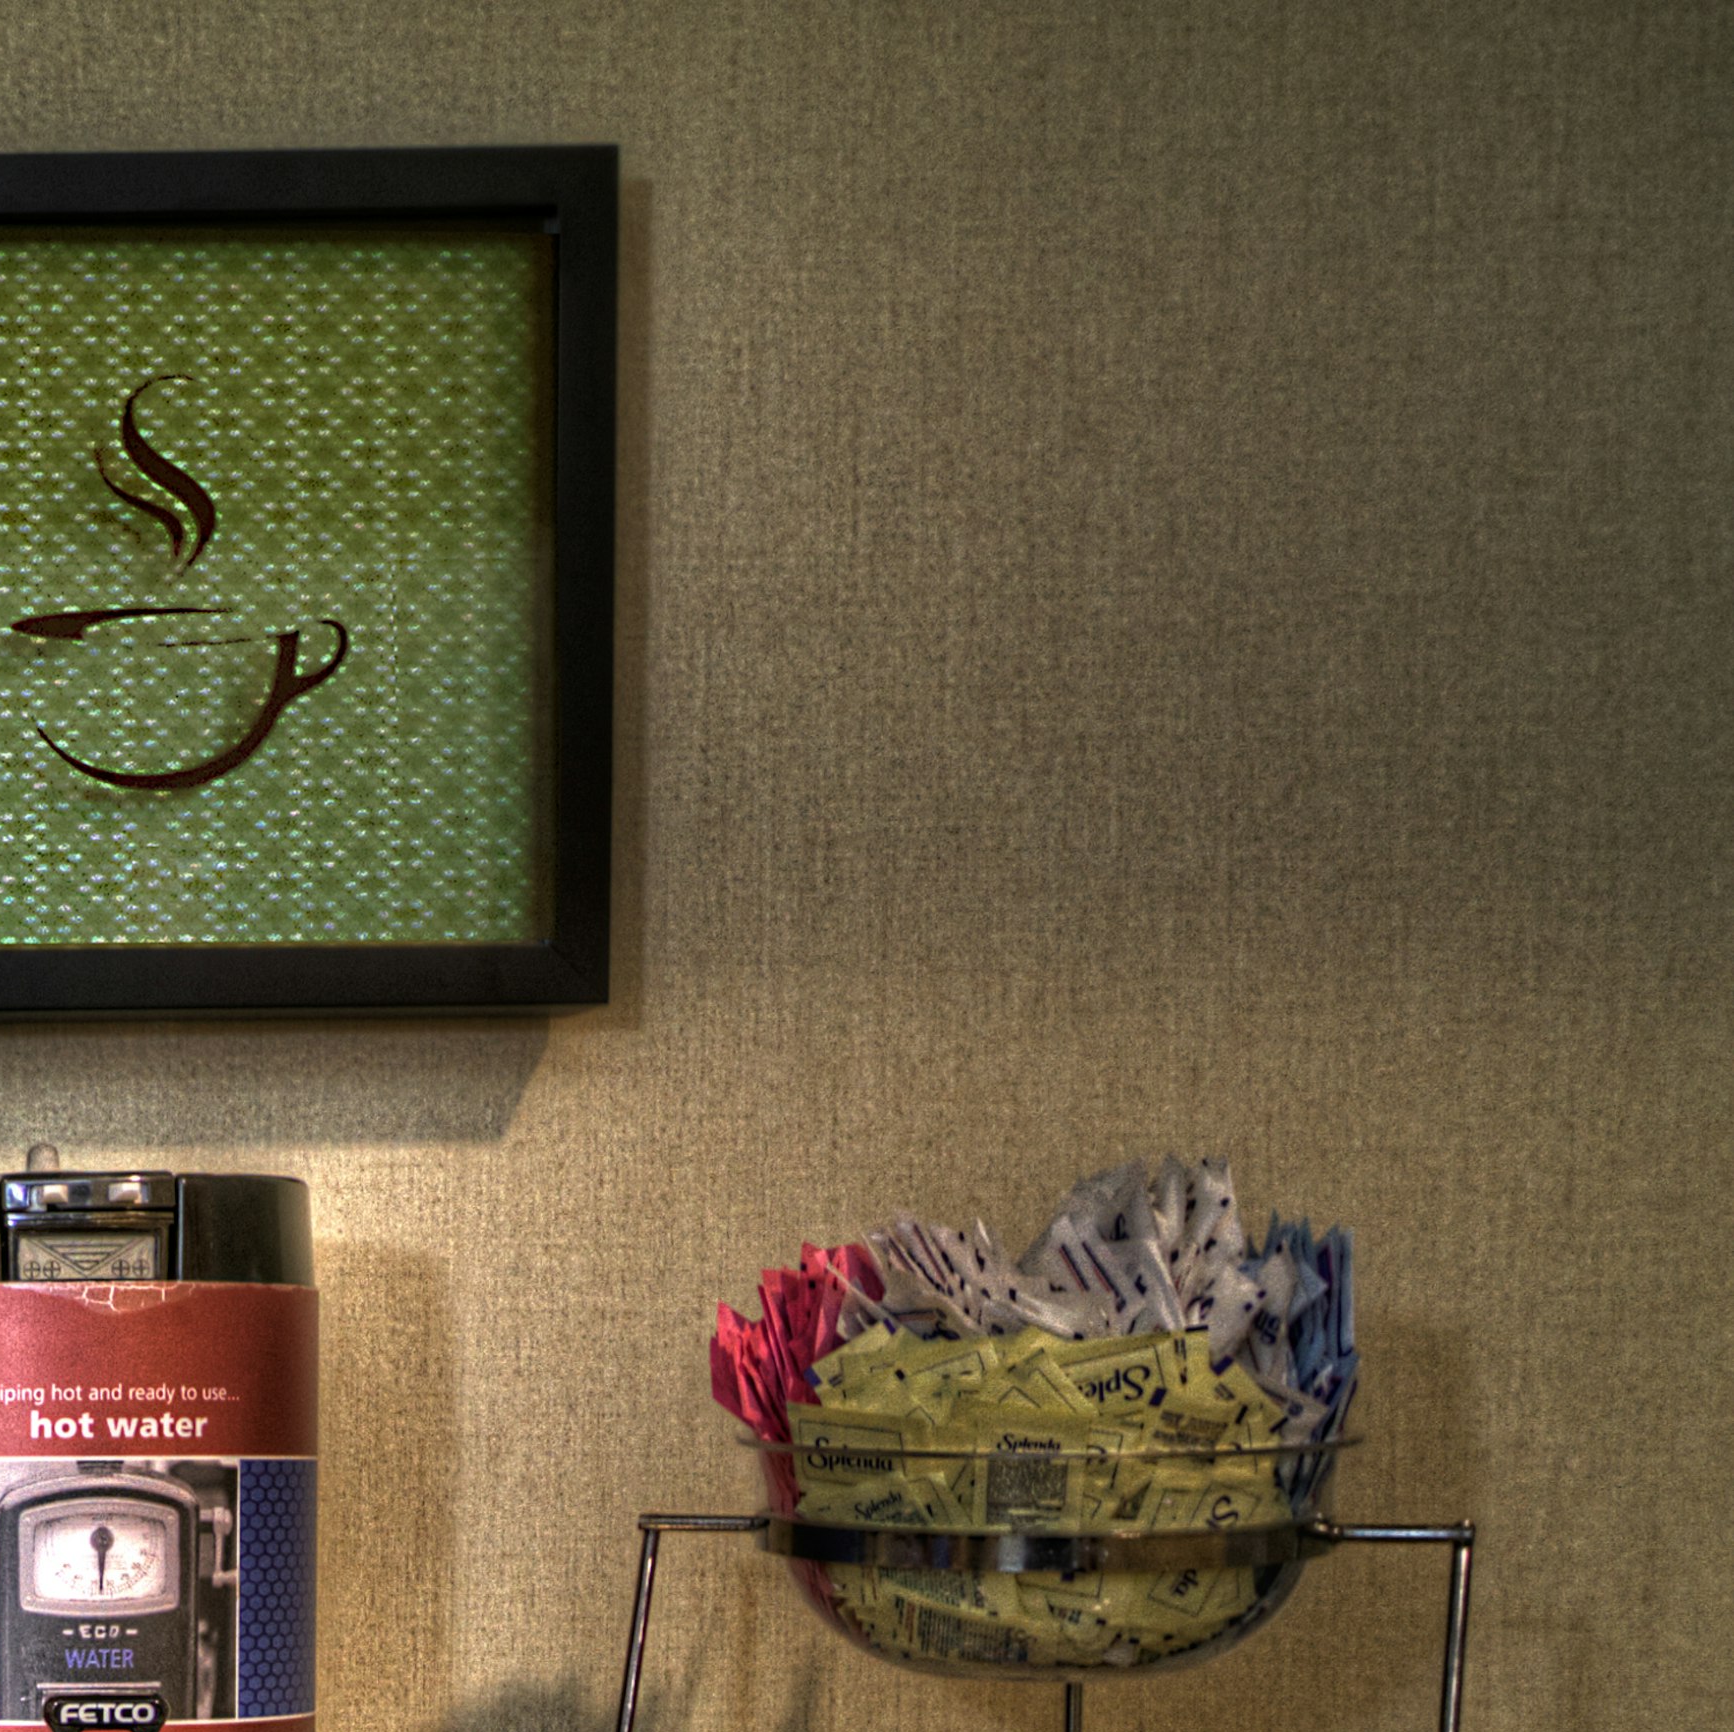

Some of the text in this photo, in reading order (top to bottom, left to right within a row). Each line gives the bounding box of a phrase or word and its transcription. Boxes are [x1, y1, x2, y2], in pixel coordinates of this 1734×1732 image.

[51, 1384, 82, 1401] hot
[89, 1384, 122, 1401] and
[128, 1383, 175, 1404] ready
[181, 1385, 197, 1401] to
[202, 1387, 239, 1401] use...
[30, 1410, 207, 1438] hot water
[65, 1649, 134, 1668] WATER
[60, 1703, 154, 1723] FETCO
